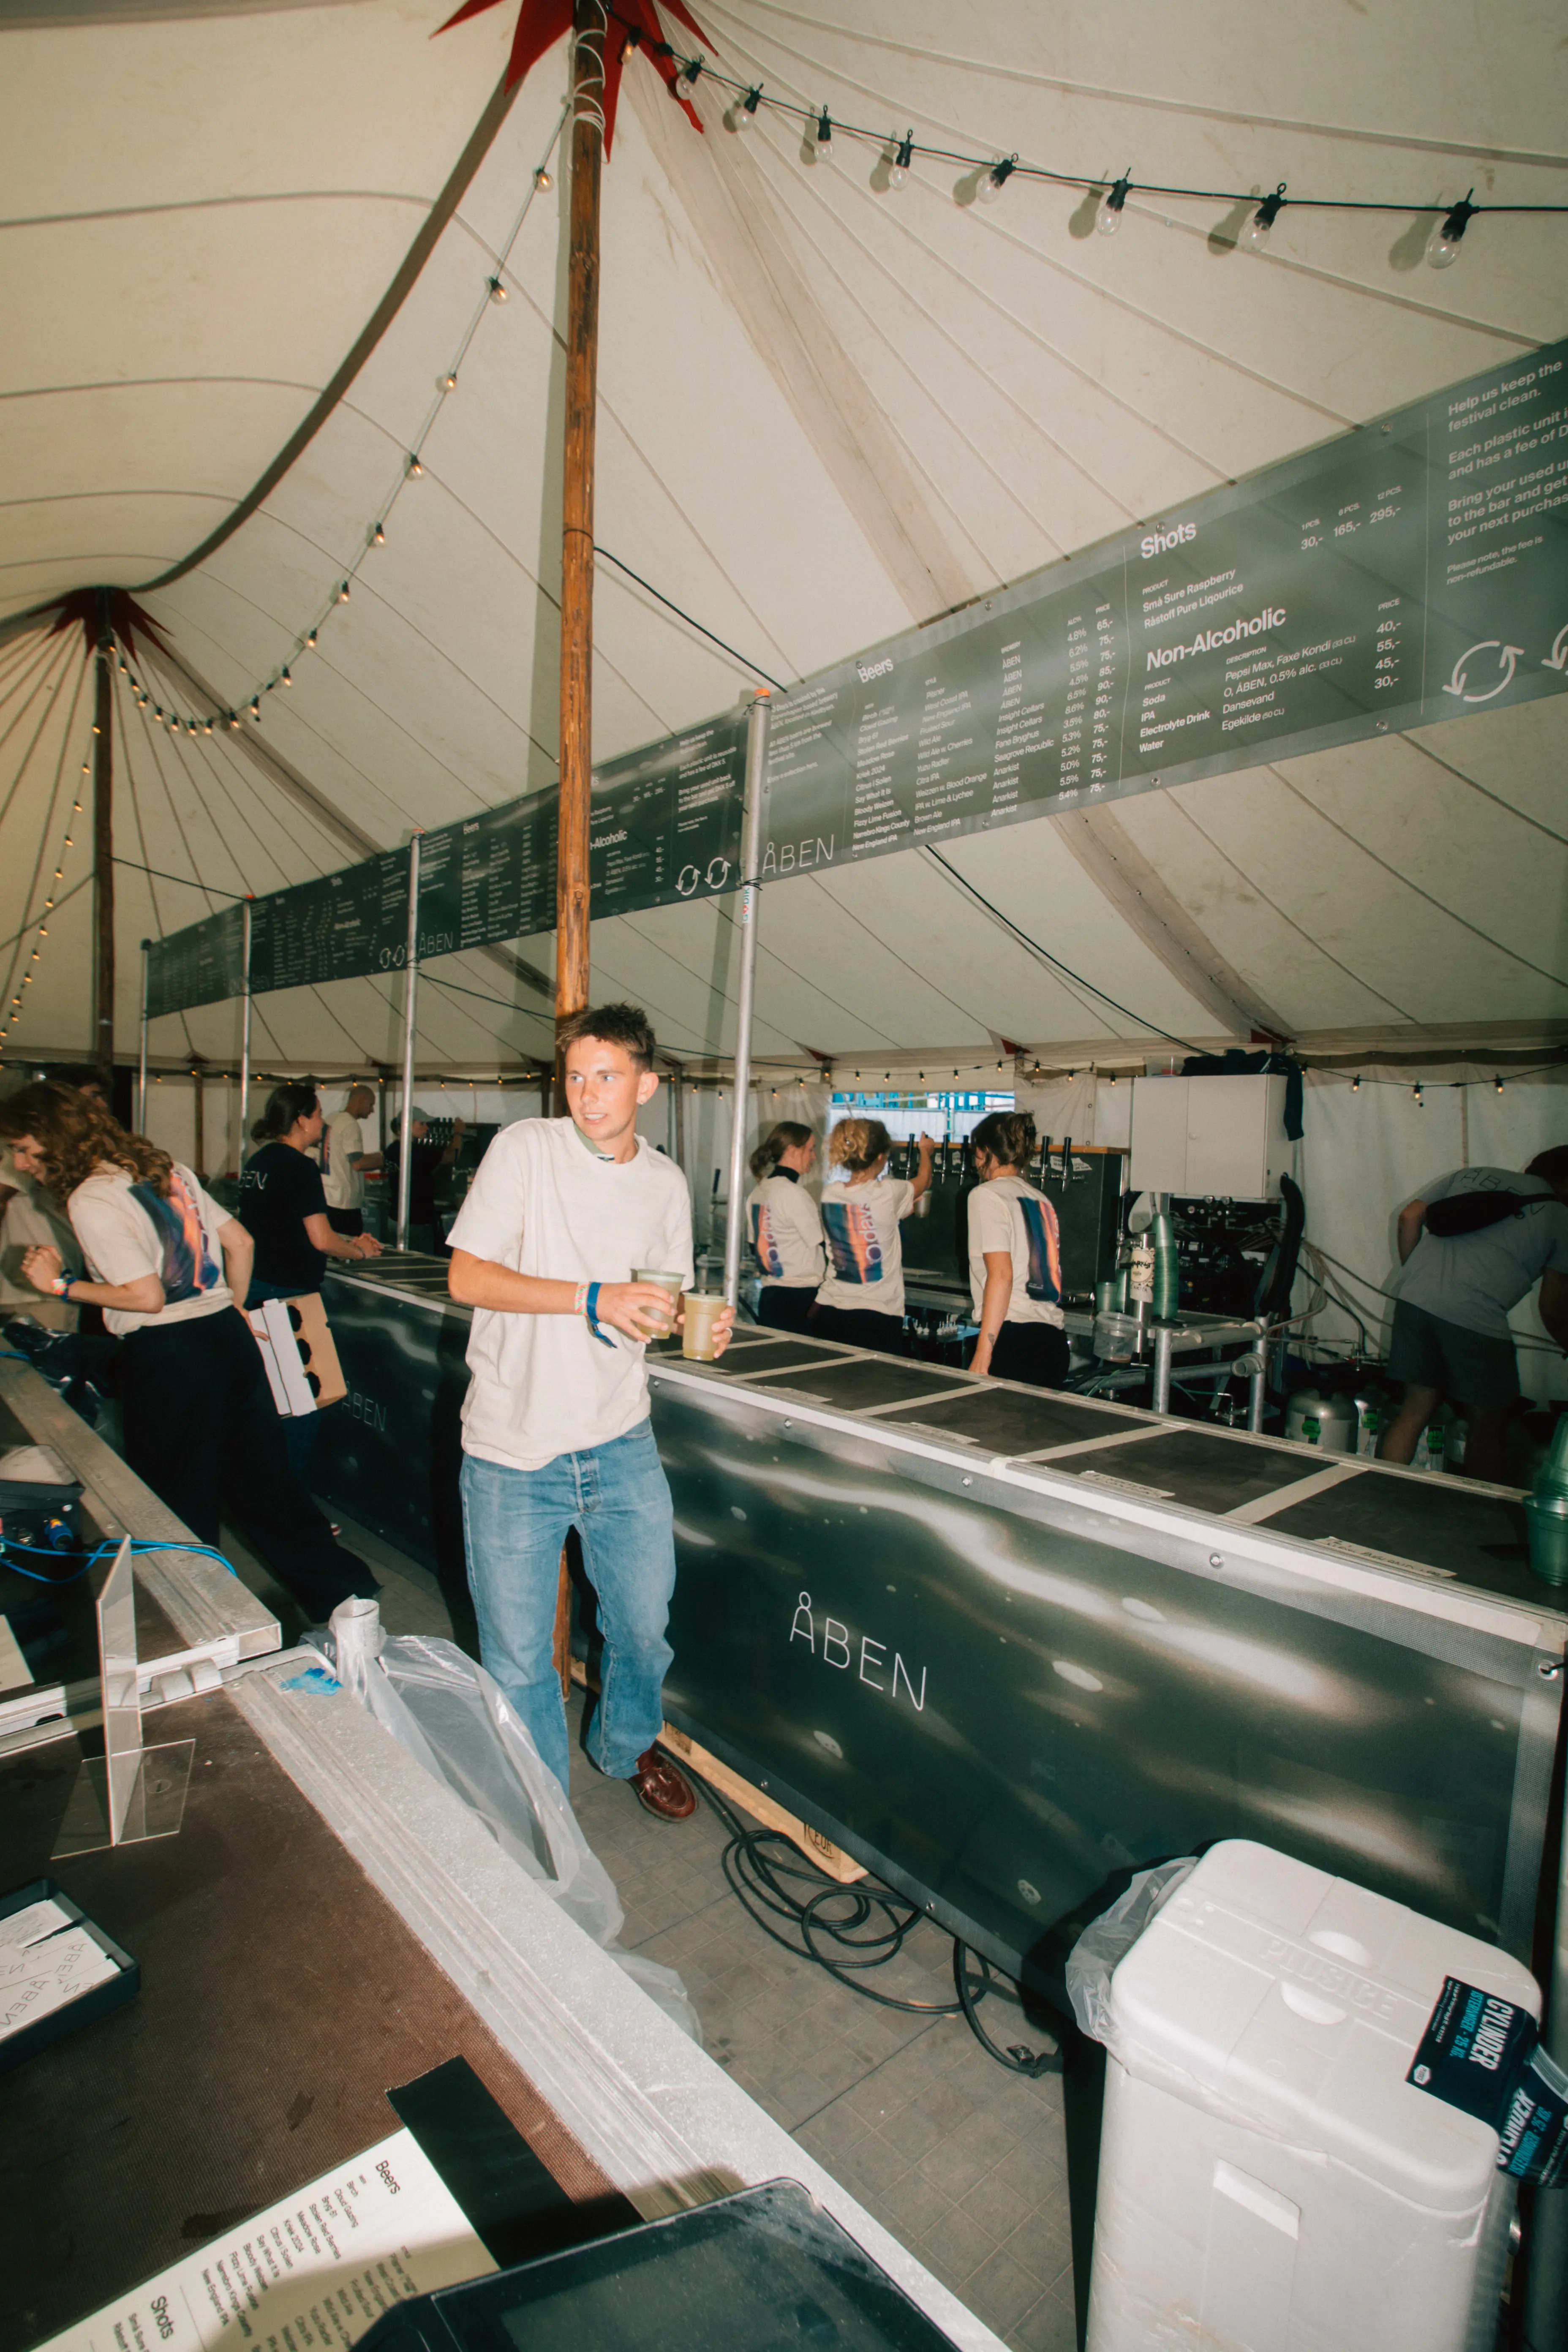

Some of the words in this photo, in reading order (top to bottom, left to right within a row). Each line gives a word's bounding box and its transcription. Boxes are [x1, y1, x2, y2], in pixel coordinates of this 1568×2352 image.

[1448, 396, 1479, 416] Help
[1481, 388, 1498, 402] us
[1500, 372, 1535, 394] keep
[1538, 361, 1562, 378] the
[1448, 403, 1496, 433] festival
[1498, 389, 1541, 411] clean.
[1448, 443, 1481, 464] Each
[1484, 425, 1530, 453] plastic
[1533, 411, 1560, 430] unit
[1448, 460, 1473, 480] and
[1476, 452, 1501, 470] has
[1503, 448, 1512, 459] a
[1514, 438, 1538, 455] fee
[1540, 428, 1555, 444] of
[1448, 492, 1483, 512] Bring
[1485, 479, 1516, 501] your
[1519, 463, 1554, 486] used
[1447, 516, 1462, 527] to
[1463, 507, 1485, 522] the
[1488, 497, 1511, 513] bar
[1514, 484, 1540, 504] and
[1543, 475, 1568, 495] get
[1369, 505, 1401, 524] 295,-
[1447, 525, 1477, 546] your
[1479, 513, 1509, 532] next
[1511, 493, 1568, 523] purchas
[1141, 522, 1197, 559] Shots
[1333, 520, 1361, 537] 165,-
[1301, 536, 1323, 550] 30,-
[1446, 558, 1477, 574] Please
[1477, 551, 1500, 564] note,
[1501, 545, 1517, 555] the
[1517, 539, 1534, 550] fee
[1534, 536, 1543, 544] is
[1446, 557, 1517, 585] non-refundable.
[1142, 579, 1168, 595] PRODUCT
[1142, 596, 1163, 612] Små
[1163, 589, 1185, 604] Sure
[1186, 569, 1236, 596] Raspberry
[1143, 608, 1175, 629] Råstoff
[1176, 602, 1198, 616] Pure
[1199, 583, 1244, 607] Liqourice
[1377, 597, 1399, 611] PRICE
[1146, 608, 1285, 671] Non-Alcoholic
[1376, 620, 1401, 634] 40,-
[1225, 646, 1266, 665] DESCRIPTION
[1376, 638, 1400, 652] 55,-
[858, 657, 894, 683] Beers
[1225, 665, 1251, 682] Pepsi
[1252, 660, 1274, 673] Max,
[1276, 651, 1300, 666] Faxe
[1301, 640, 1331, 658] Kondi
[1375, 656, 1399, 670] 45,-
[1144, 677, 1171, 691] PRODUCT
[1223, 687, 1233, 697] O,
[1235, 677, 1267, 694] ÅBEN,
[1269, 667, 1297, 684] 0.5%
[1298, 664, 1316, 675] alc.
[1374, 675, 1399, 689] 30,-
[998, 709, 1021, 722] Insight
[1021, 702, 1045, 715] Cellars
[1142, 694, 1165, 707] Soda
[1222, 690, 1274, 714] Dansevand
[996, 722, 1019, 735] Insight
[1018, 716, 1043, 729] Cellars
[1140, 718, 1186, 738] Electrolyte
[1186, 710, 1210, 724] Drink
[1141, 710, 1155, 722] IPA
[1221, 712, 1261, 731] Egekilde
[1011, 730, 1040, 744] Bryghus
[1139, 740, 1164, 753] Water
[994, 748, 1025, 763] Seagrove
[1024, 738, 1054, 754] Republic
[993, 762, 1019, 776] Anarkist
[992, 776, 1019, 790] Anarkist
[991, 790, 1018, 803] Anarkist
[990, 804, 1018, 817] Anarkist
[762, 834, 835, 874] ÅBEN
[789, 1591, 927, 1711] ÅBEN
[1454, 2034, 1469, 2047] 25
[1468, 1998, 1514, 2070] CYLINDER
[346, 2180, 359, 2197] Birch
[375, 2159, 400, 2194] Beers
[321, 2195, 333, 2212] Bryg
[334, 2188, 348, 2207] Cloud
[343, 2205, 359, 2228] Gazing
[290, 2235, 304, 2253] 2024
[297, 2210, 313, 2238] Meadow
[310, 2236, 321, 2254] Rose
[308, 2203, 322, 2224] Stolen
[320, 2221, 330, 2237] Red
[325, 2234, 341, 2260] Berries
[242, 2242, 257, 2267] Bloody
[256, 2234, 266, 2248] Say
[262, 2247, 275, 2266] What
[270, 2226, 283, 2247] Citrus
[280, 2248, 294, 2269] Solen
[229, 2251, 240, 2270] Fizzy
[236, 2268, 248, 2287] Lime
[202, 2268, 211, 2285] New
[207, 2283, 225, 2314] England
[229, 2290, 243, 2313] Kings
[150, 2295, 174, 2339] Shots
